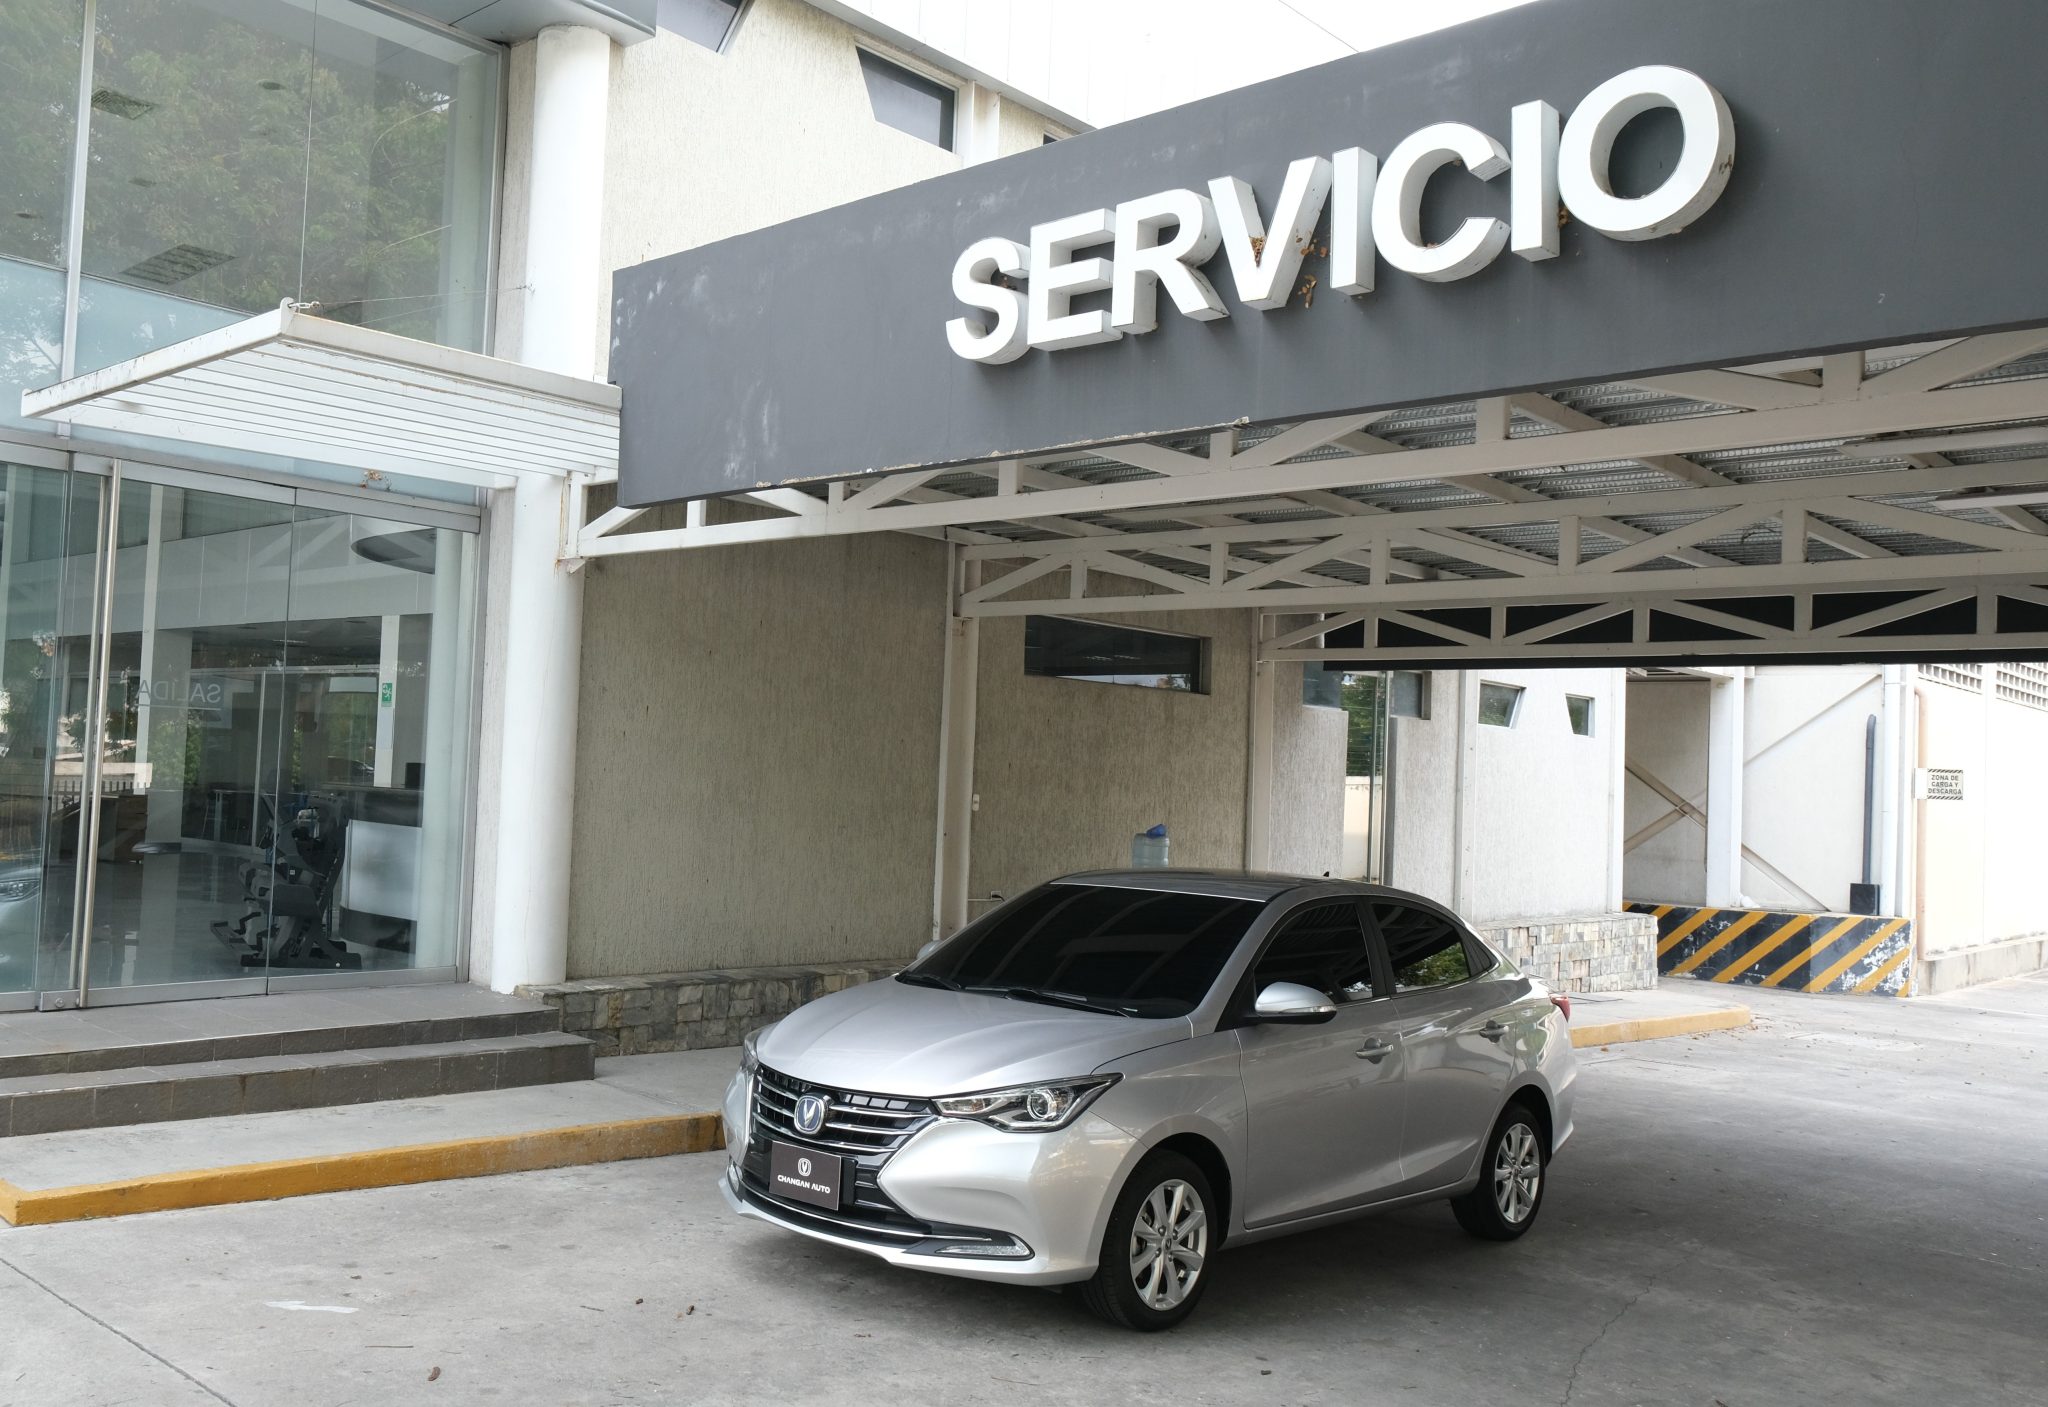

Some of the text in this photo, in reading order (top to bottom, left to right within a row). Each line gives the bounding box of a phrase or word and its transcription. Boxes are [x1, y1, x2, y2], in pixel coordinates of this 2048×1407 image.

[946, 65, 1736, 365] SERVICIO
[777, 1174, 831, 1194] CHANGAN AUTO
